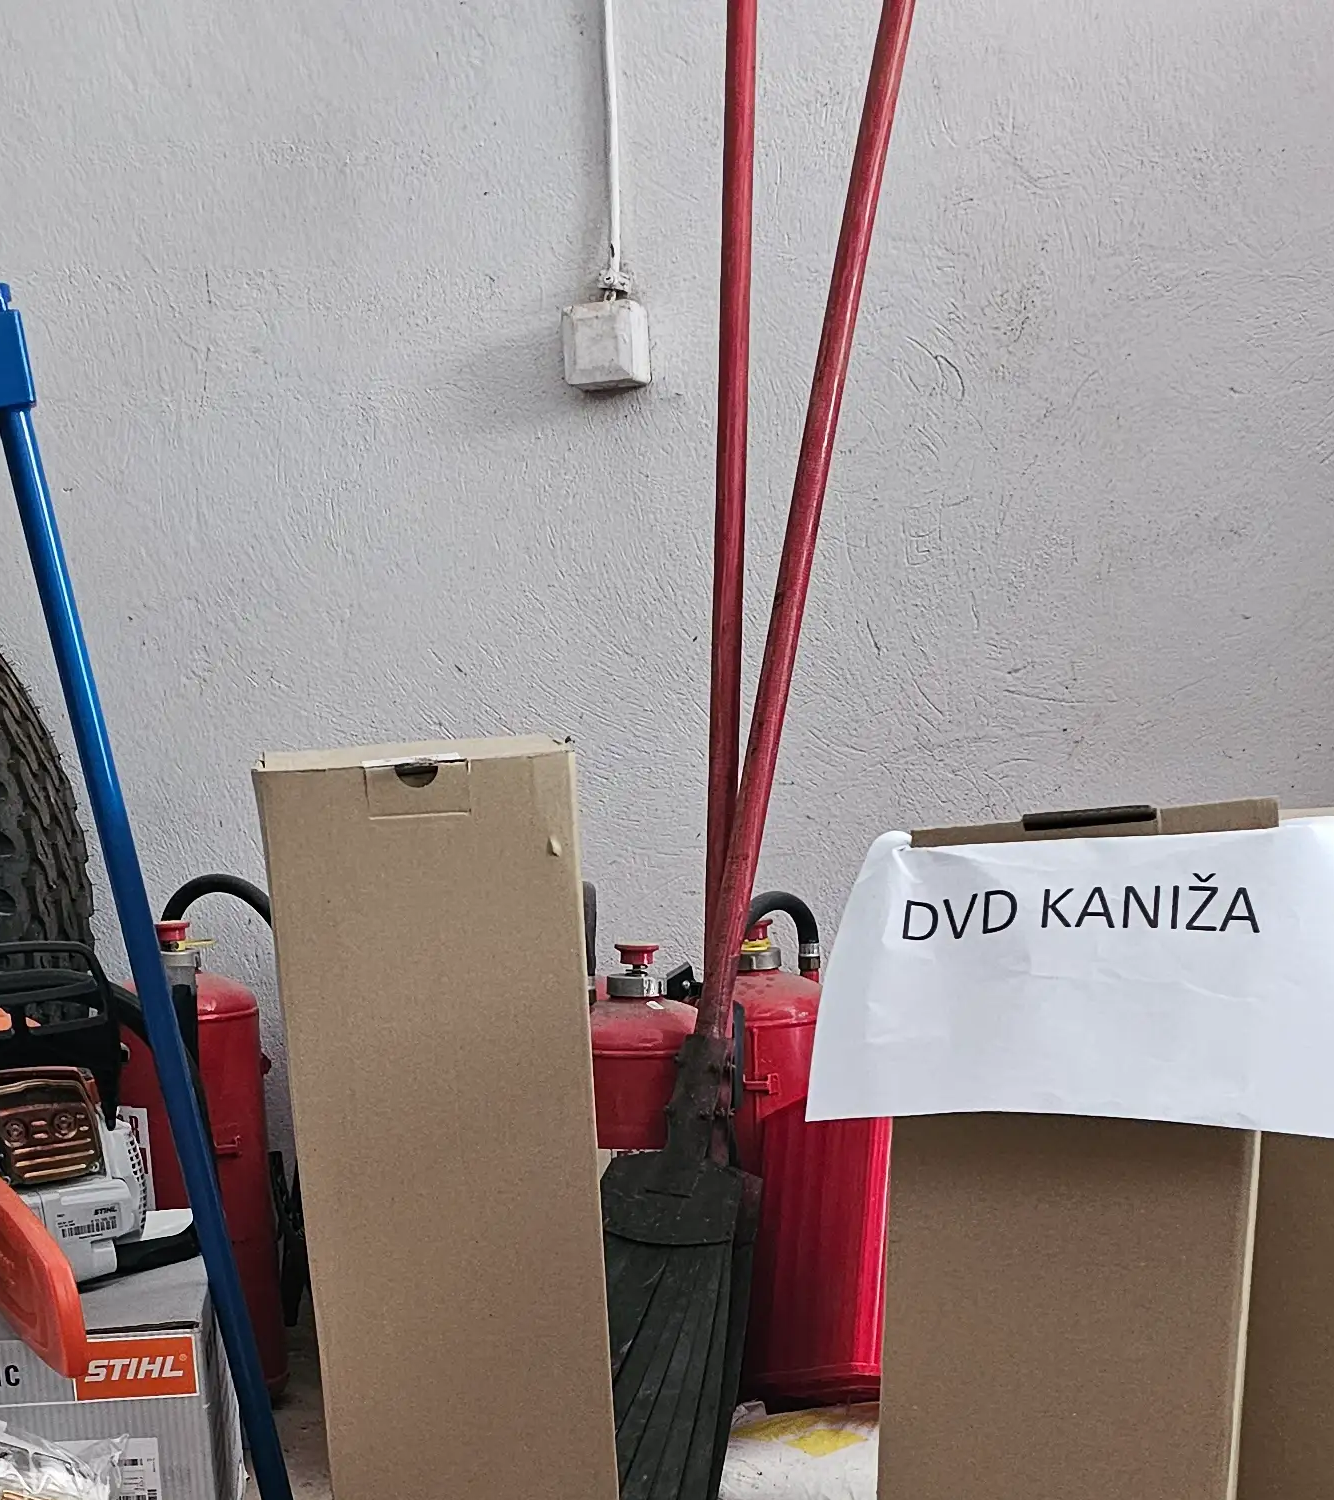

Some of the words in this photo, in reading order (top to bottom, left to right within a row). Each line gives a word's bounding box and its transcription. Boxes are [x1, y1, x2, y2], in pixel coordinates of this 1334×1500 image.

[902, 889, 1018, 941] DVD
[1041, 873, 1260, 933] KANIŽA
[85, 1355, 184, 1382] STIHL
